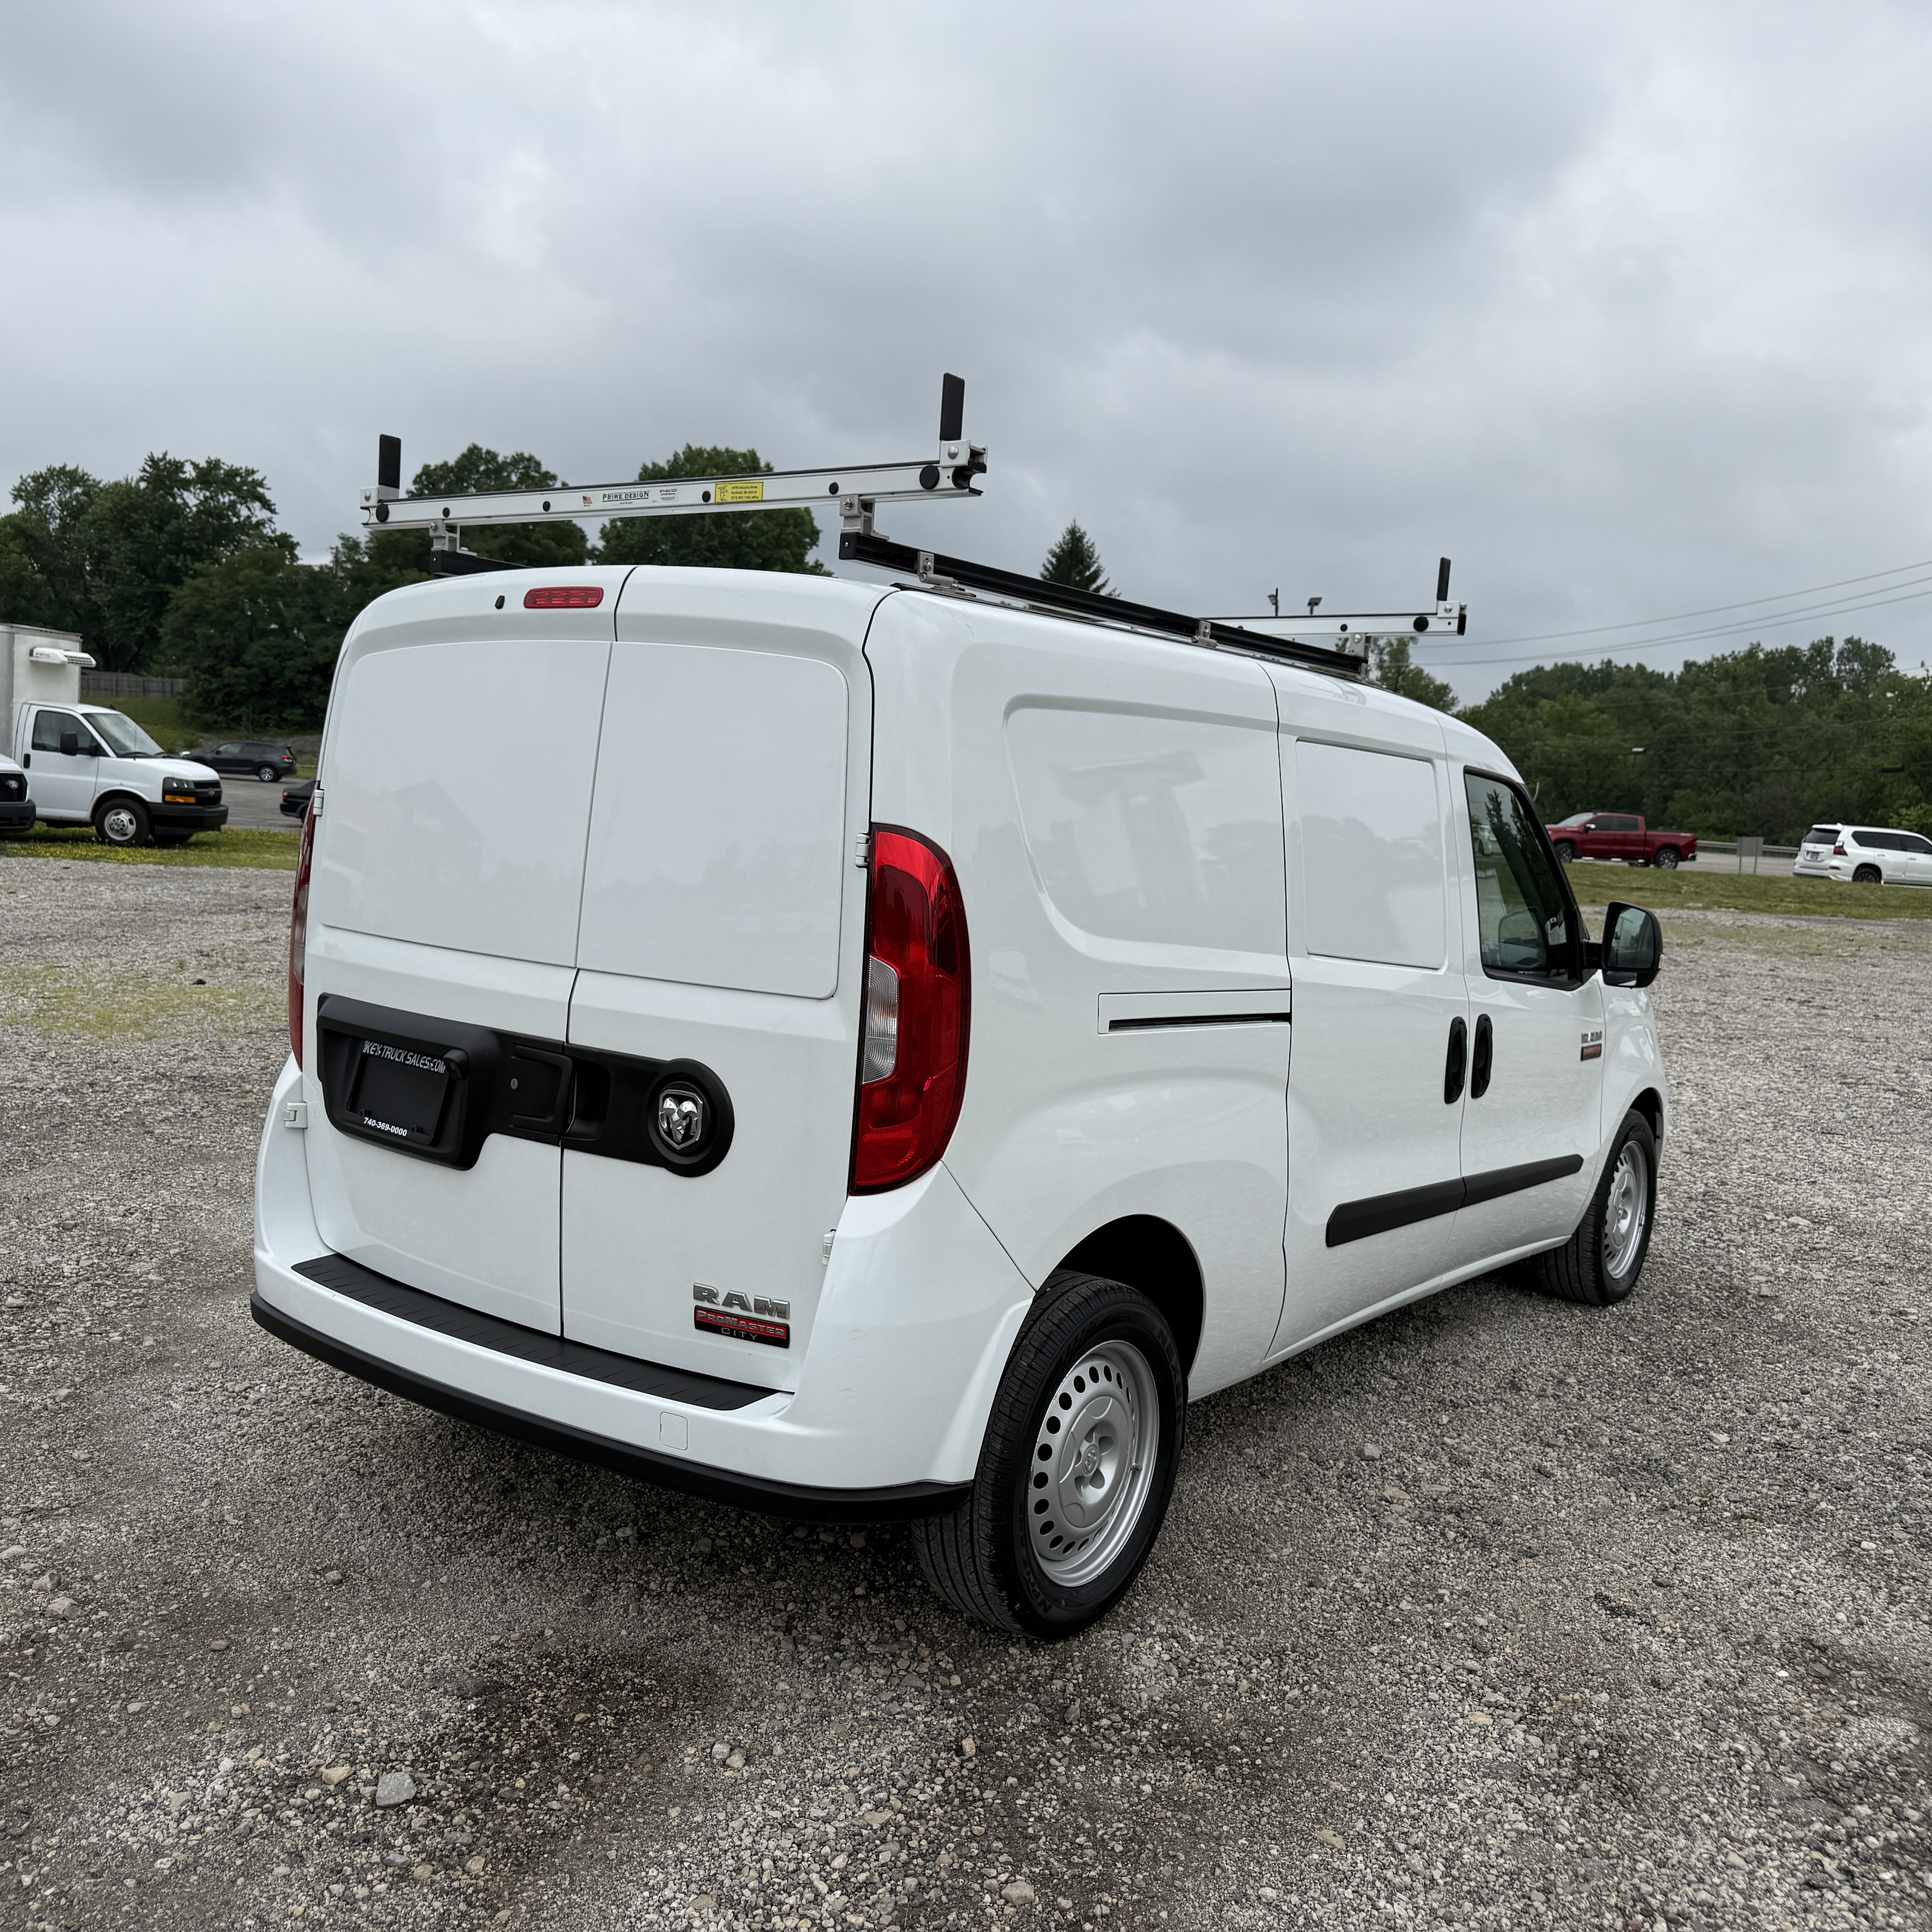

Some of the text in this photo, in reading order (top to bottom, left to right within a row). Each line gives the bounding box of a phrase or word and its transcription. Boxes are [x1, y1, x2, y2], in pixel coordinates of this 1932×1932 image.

[625, 491, 649, 499] DESIGN
[381, 1045, 408, 1063] TRUCK
[363, 1117, 408, 1136] 740-369-0000
[693, 1282, 790, 1320] RAM
[721, 1327, 758, 1340] CITY
[1157, 1327, 1182, 1425] NEXEN
